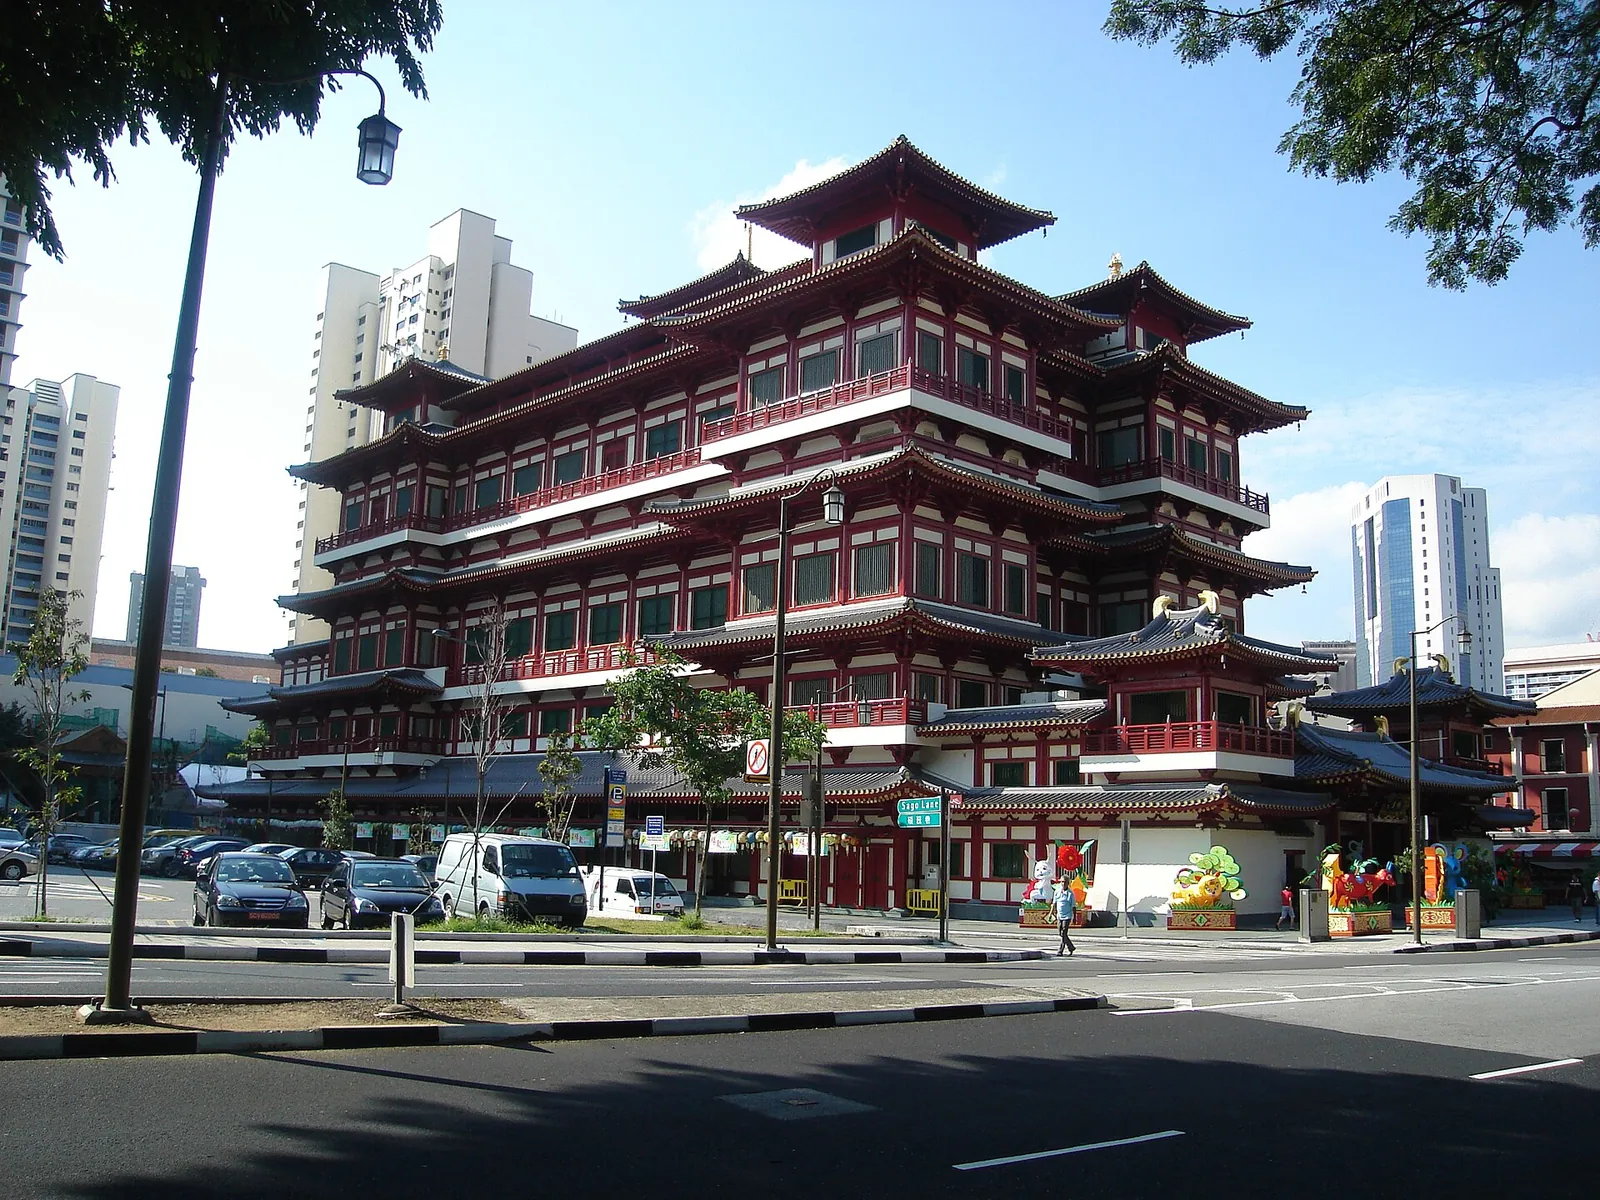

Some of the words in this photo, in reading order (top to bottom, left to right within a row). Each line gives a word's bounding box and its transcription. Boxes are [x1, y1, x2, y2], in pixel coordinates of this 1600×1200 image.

[613, 787, 623, 799] P
[901, 801, 919, 811] Sago
[921, 800, 939, 809] Lane
